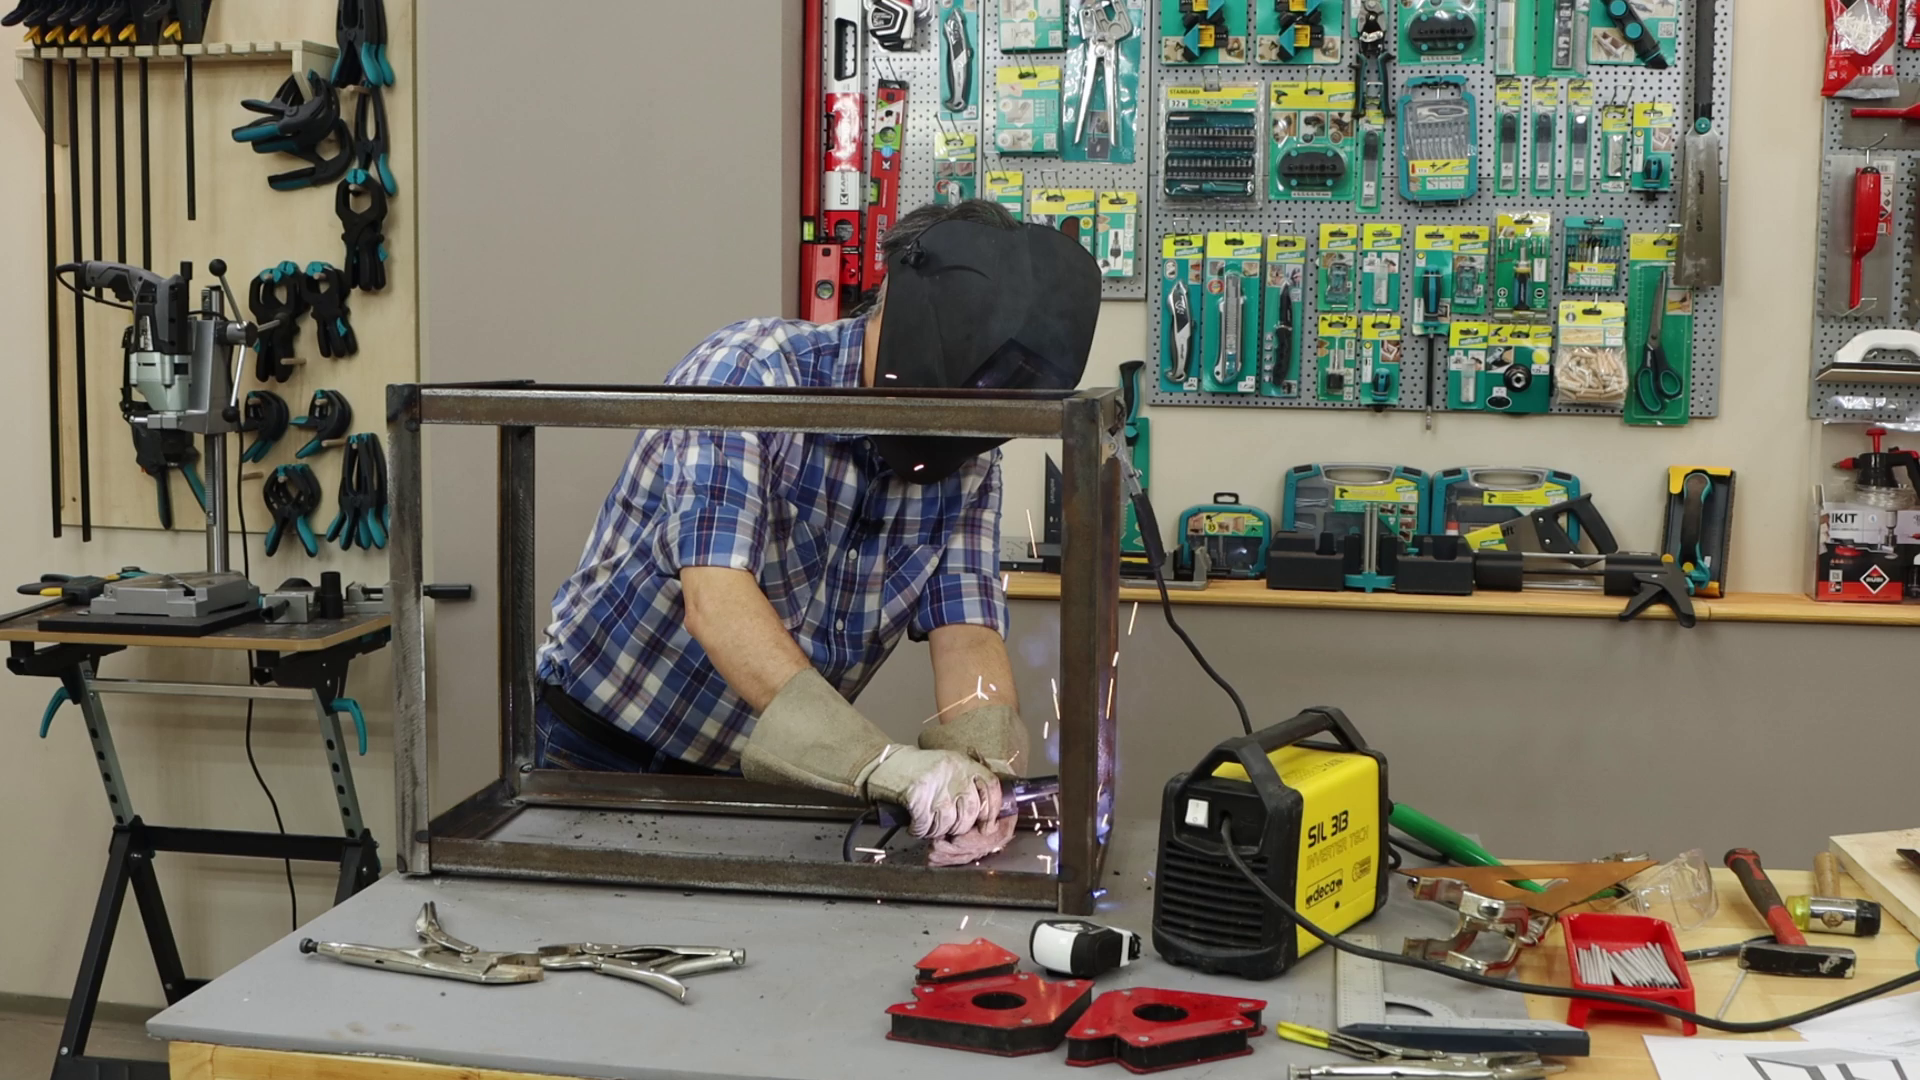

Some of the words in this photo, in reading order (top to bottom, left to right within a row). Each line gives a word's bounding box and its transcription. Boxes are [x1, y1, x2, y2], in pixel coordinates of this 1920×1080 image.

[1306, 836, 1347, 872] INVERTER
[1349, 825, 1370, 849] TECH
[1308, 821, 1327, 849] SIL
[1313, 880, 1336, 902] deca
